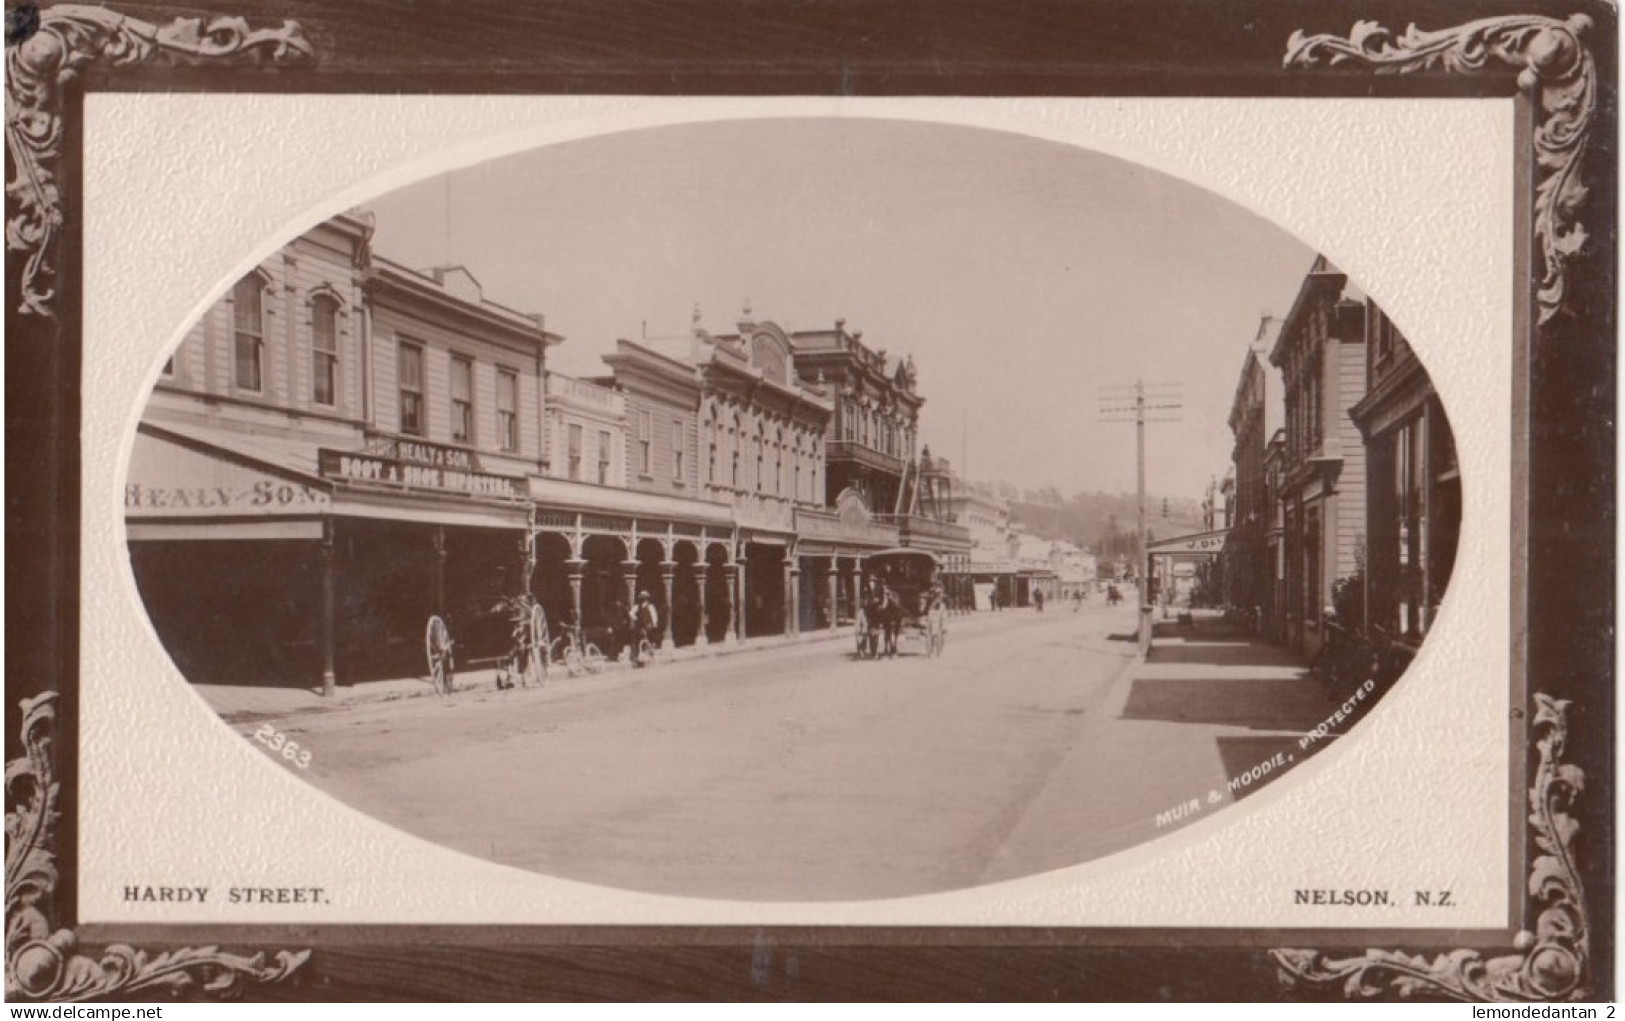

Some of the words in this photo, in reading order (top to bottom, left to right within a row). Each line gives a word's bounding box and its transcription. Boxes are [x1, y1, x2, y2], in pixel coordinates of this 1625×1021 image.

[399, 440, 436, 465] HEALY
[340, 456, 383, 480] BOOT
[404, 466, 439, 487] SHOE
